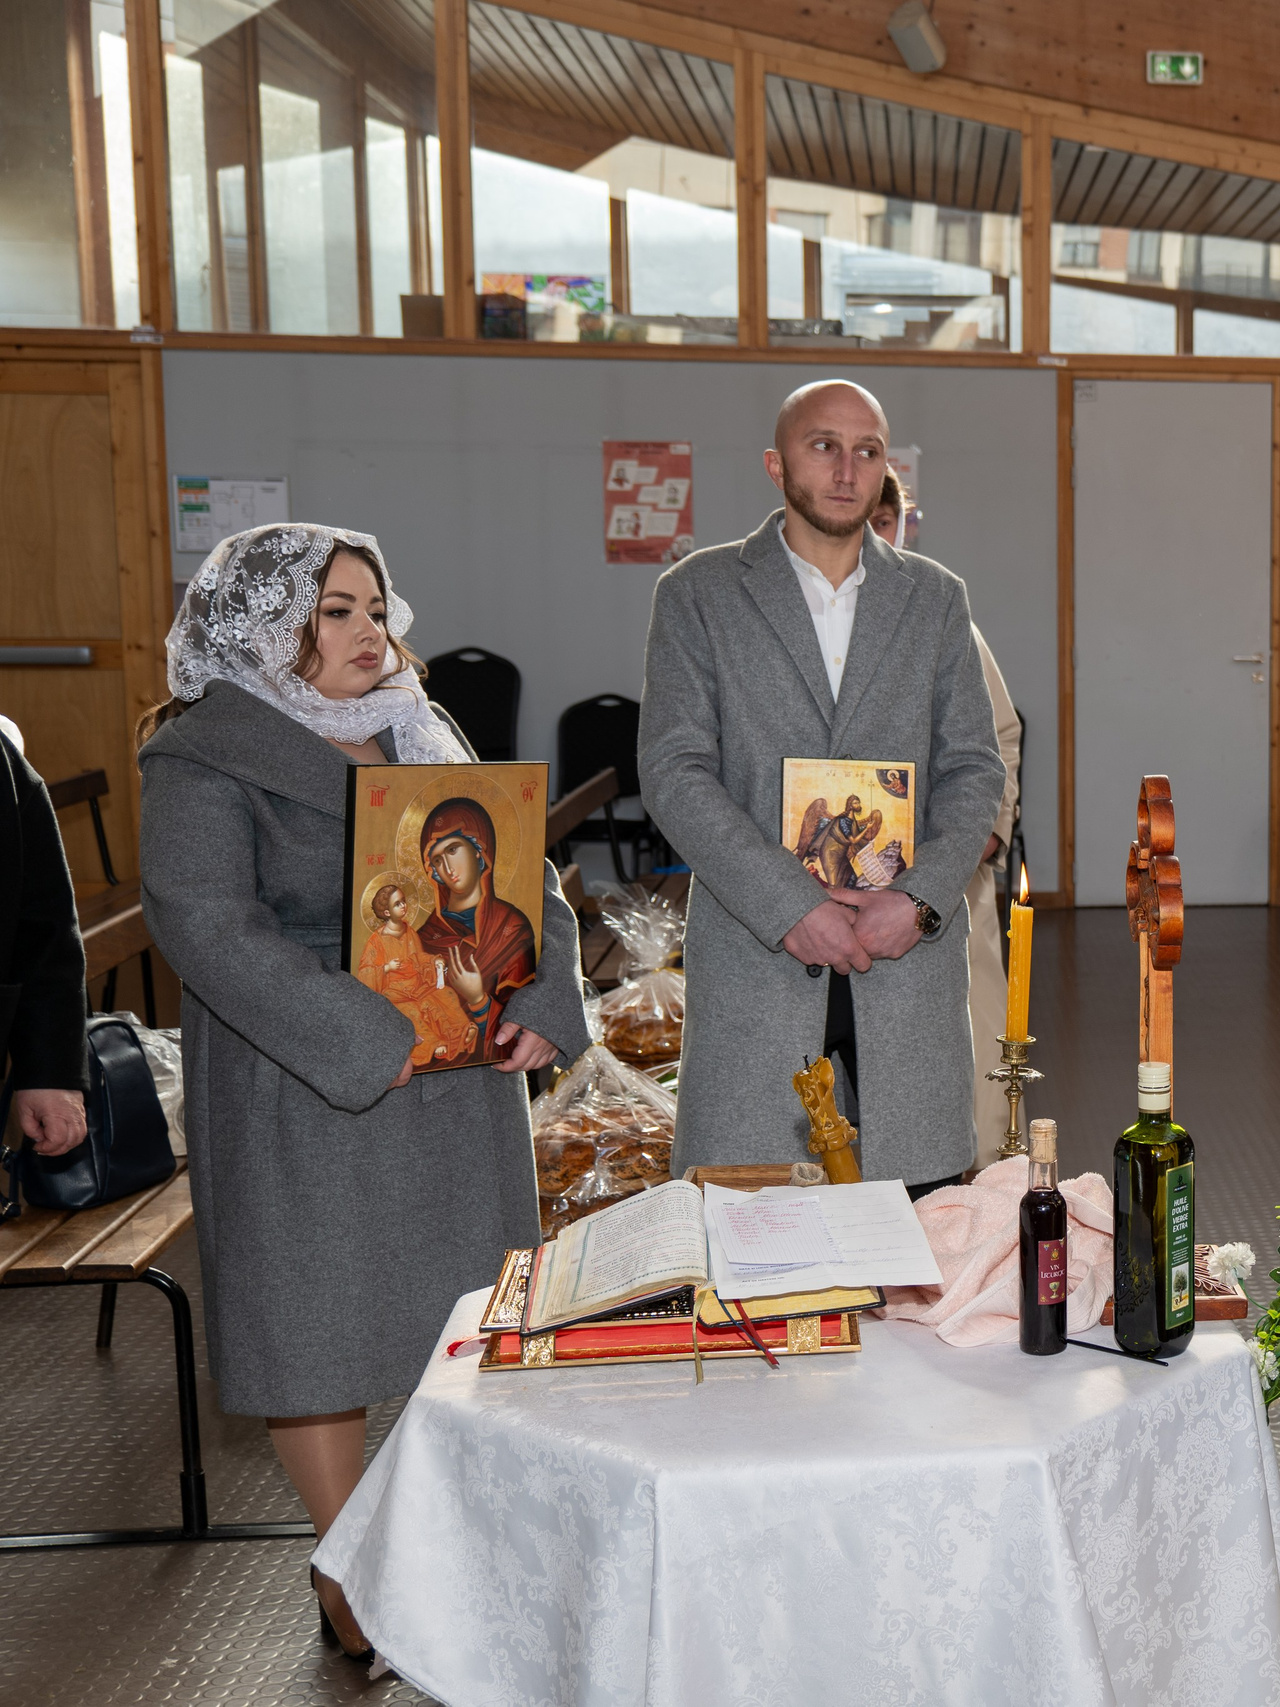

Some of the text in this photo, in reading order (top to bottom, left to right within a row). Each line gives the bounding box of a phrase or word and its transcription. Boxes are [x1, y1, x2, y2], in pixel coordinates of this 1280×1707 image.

[1173, 1196, 1188, 1207] HUILE
[1171, 1204, 1189, 1216] D'OLIVE
[1172, 1213, 1189, 1224] VIERGE
[1172, 1222, 1189, 1233] EXTRA
